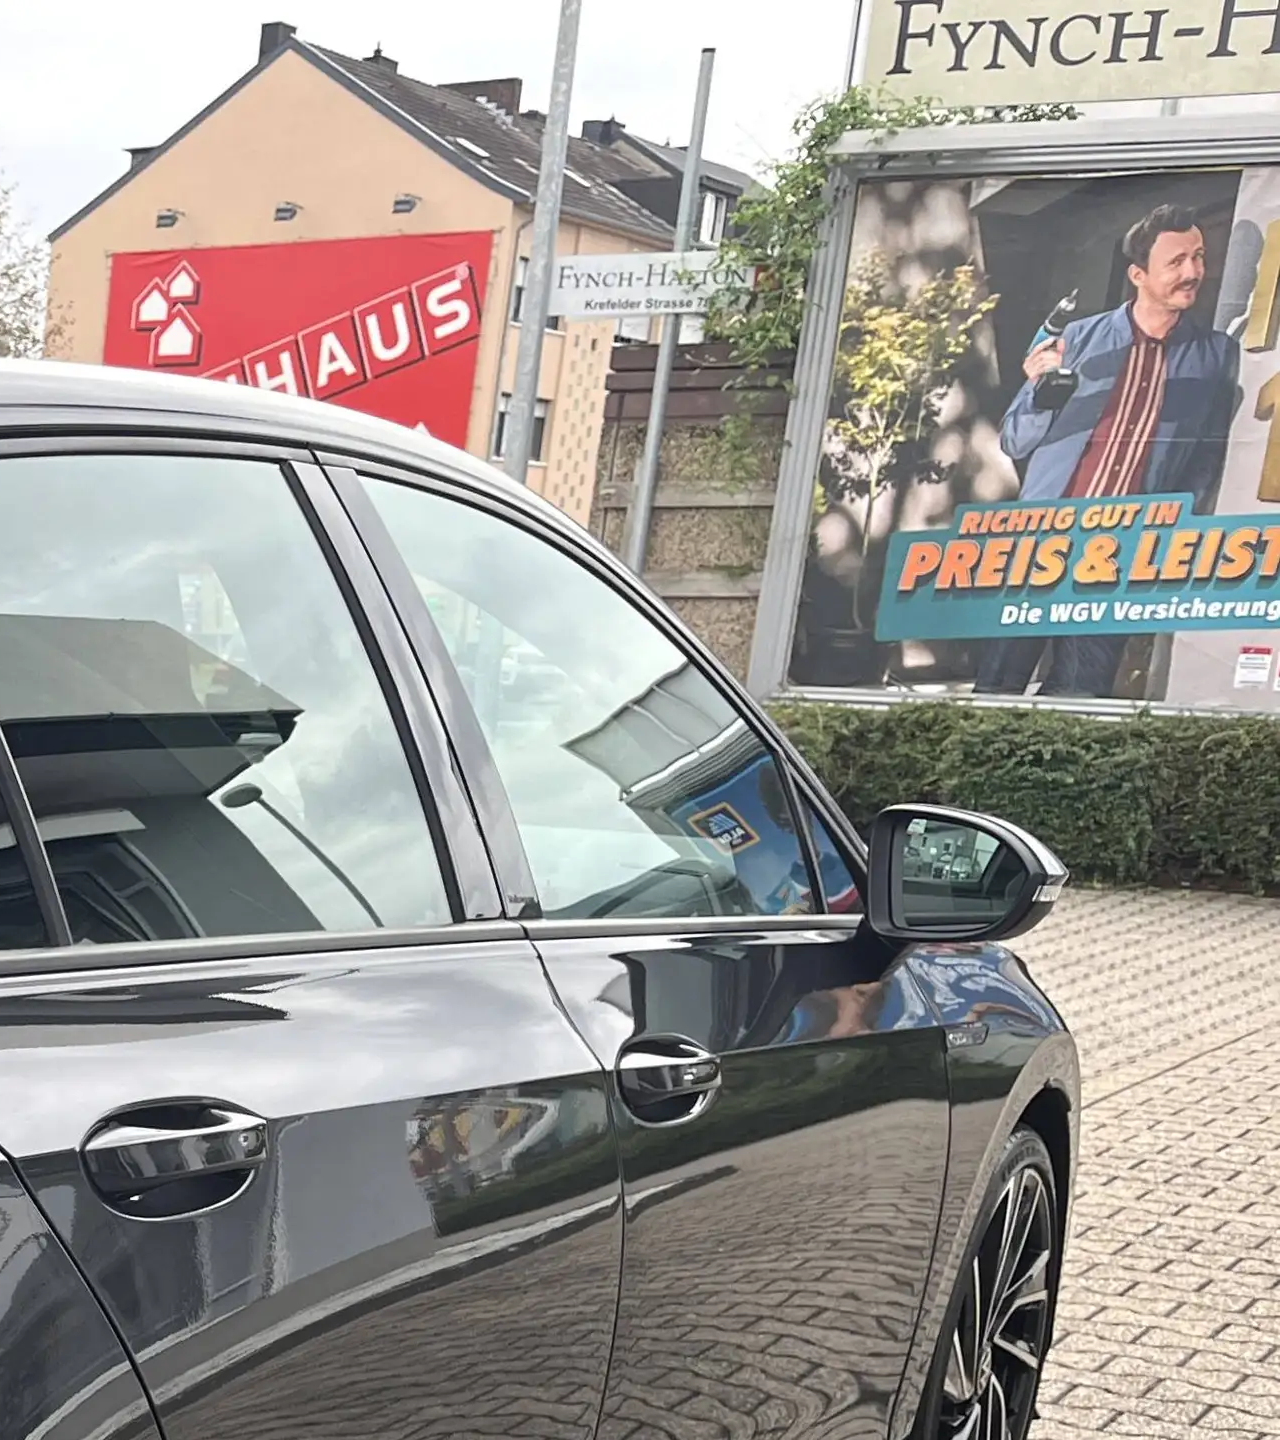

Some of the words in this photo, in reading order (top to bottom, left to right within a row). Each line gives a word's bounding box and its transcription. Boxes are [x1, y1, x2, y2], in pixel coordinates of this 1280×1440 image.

[585, 298, 641, 310] Krefelder
[645, 297, 694, 309] Strasse
[224, 279, 471, 397] HAUS
[959, 506, 1075, 535] RICHTIG
[1081, 503, 1142, 529] GUT
[1144, 501, 1182, 526] IN
[897, 534, 1072, 592] PREIS
[1073, 534, 1120, 584] &
[1000, 604, 1042, 625] Die
[1049, 602, 1107, 623] WGV
